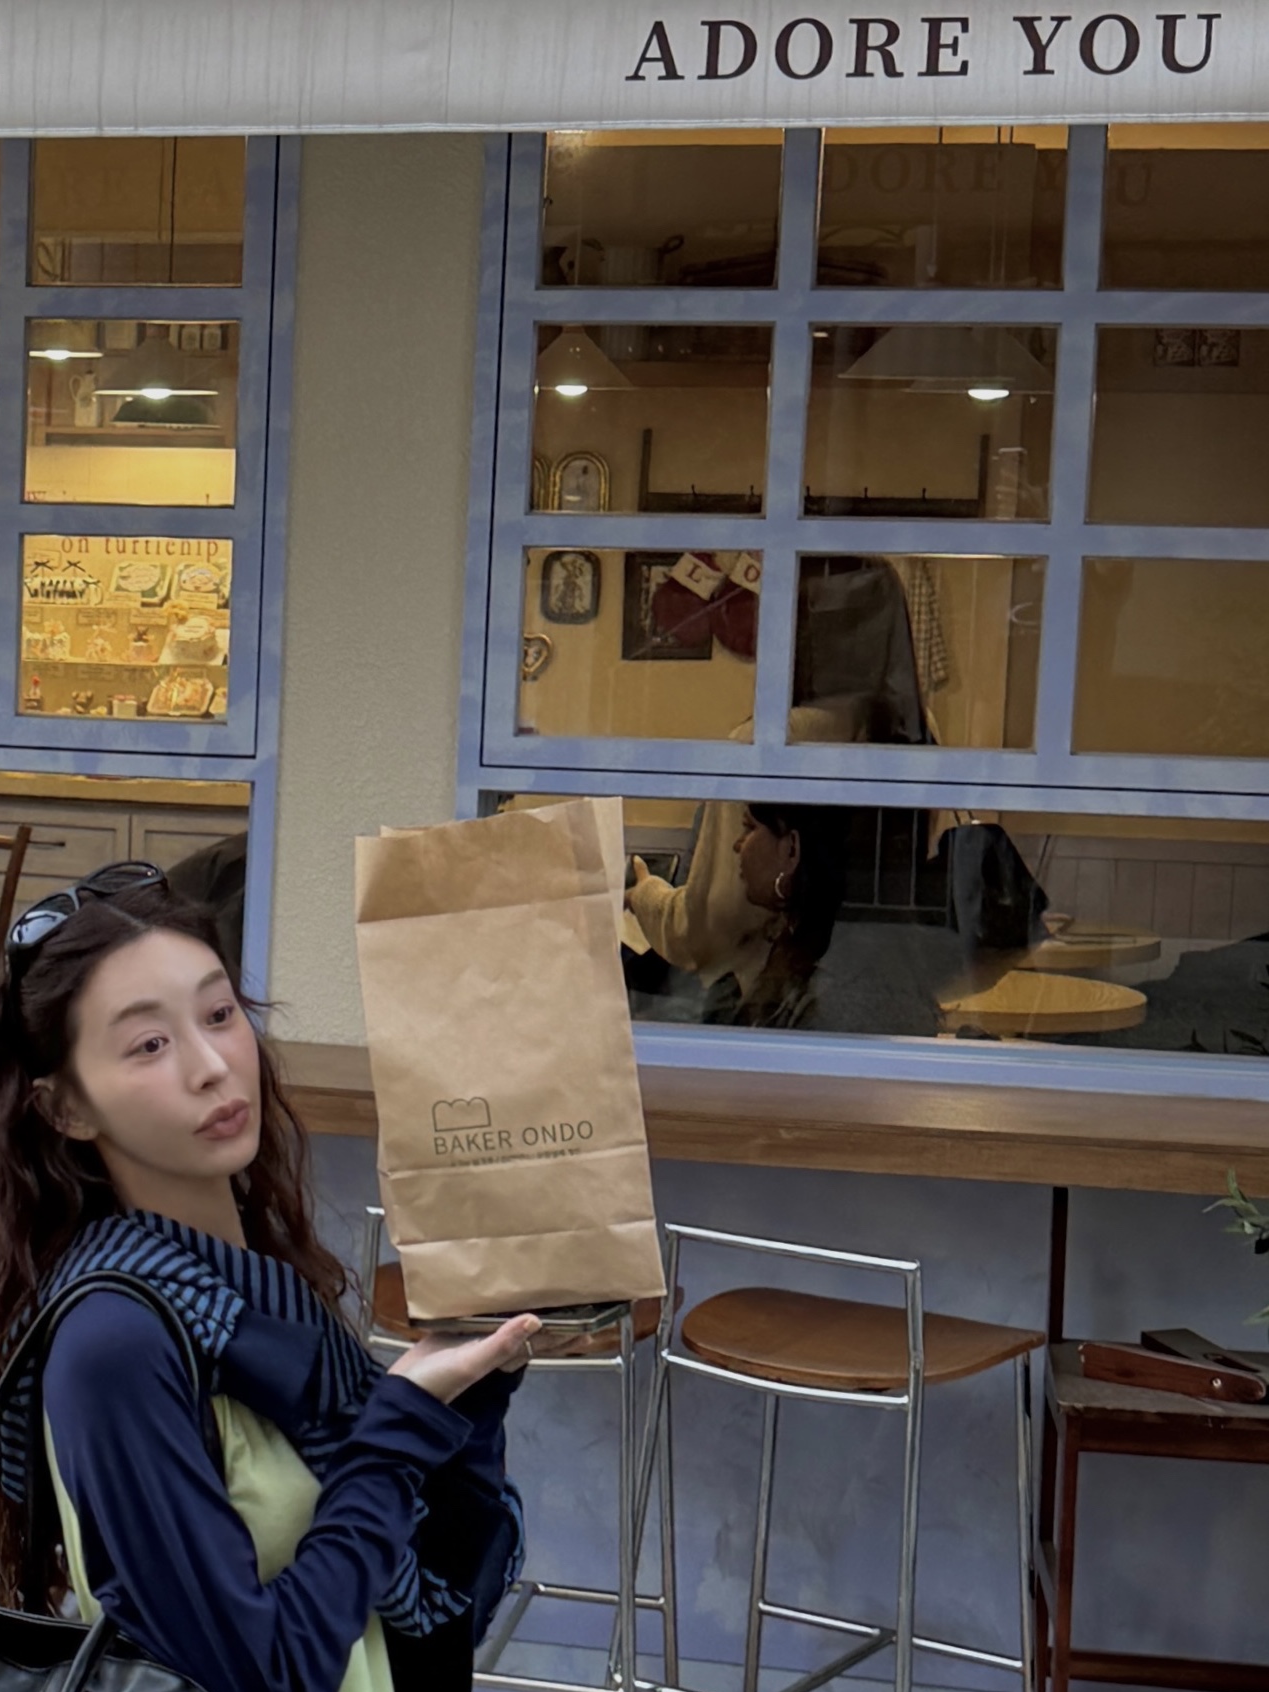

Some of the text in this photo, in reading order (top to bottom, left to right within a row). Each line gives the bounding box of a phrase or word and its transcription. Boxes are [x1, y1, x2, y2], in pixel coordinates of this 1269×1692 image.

[625, 13, 1222, 82] ADORE YOU
[433, 1120, 594, 1155] BAKER ONDO
